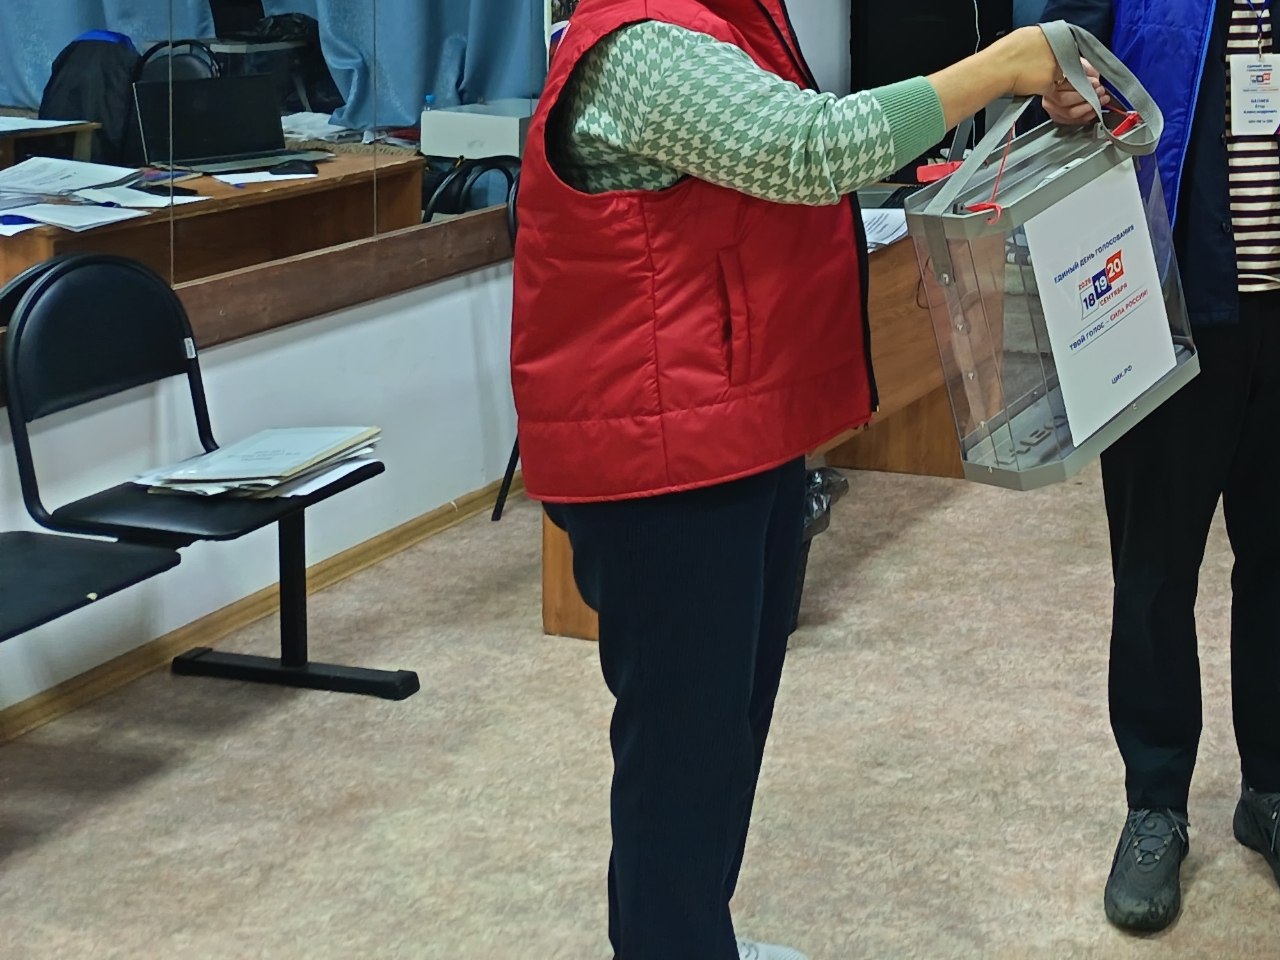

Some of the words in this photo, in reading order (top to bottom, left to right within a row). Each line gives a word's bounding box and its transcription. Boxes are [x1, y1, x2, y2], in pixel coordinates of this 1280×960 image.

[1054, 261, 1080, 284] ЕДИНЫЙ
[1080, 253, 1095, 267] ДЕНЬ
[1095, 224, 1135, 256] ГОЛОСОВАНИЯ
[1083, 292, 1096, 310] 18
[1094, 276, 1108, 294] 19
[1106, 258, 1122, 277] 20
[1100, 282, 1128, 306] СЕНТЯБРЯ
[1069, 334, 1086, 351] ТВОЙ
[1085, 321, 1105, 340] ГОЛОС
[1109, 307, 1125, 321] СИЛА
